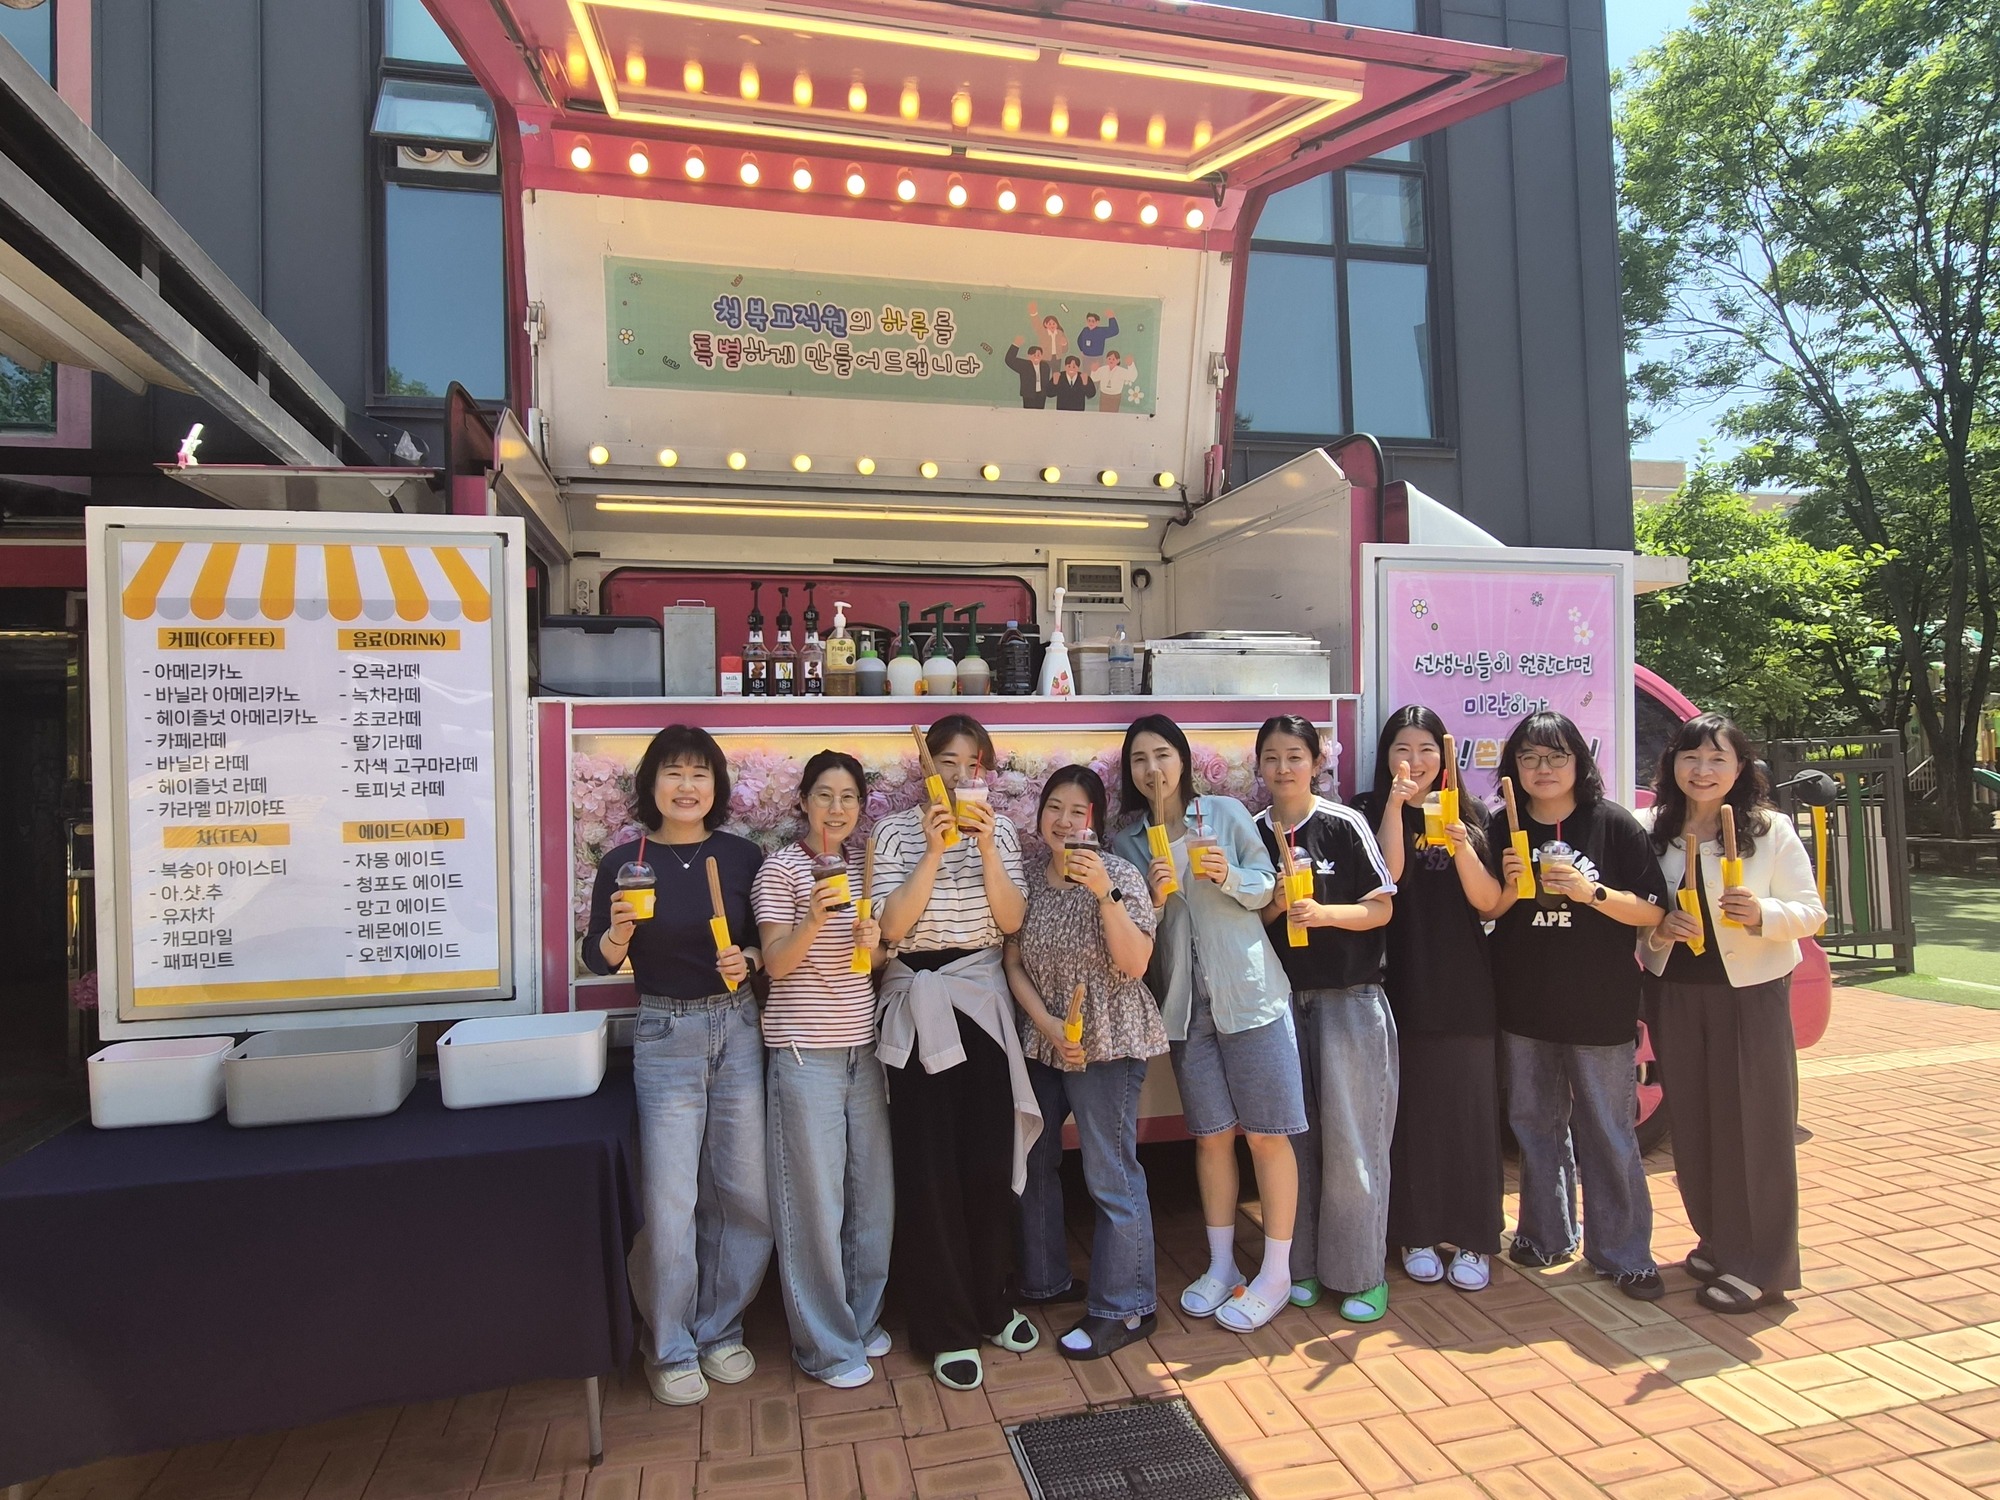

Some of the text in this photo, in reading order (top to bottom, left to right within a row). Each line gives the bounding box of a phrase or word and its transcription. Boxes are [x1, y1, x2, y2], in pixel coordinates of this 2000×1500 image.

[714, 295, 955, 346] 청북교직원의 하루를
[693, 333, 981, 377] 특별하게 만들어드립니다
[168, 631, 275, 648] 커피(COFFEE)
[353, 631, 446, 647] 음료(DRINK)
[155, 663, 243, 680] 아메리카노
[351, 663, 420, 680] 오곡라떼
[1415, 652, 1592, 681] 선생님들이 원한다면
[156, 686, 300, 703] 바닐라 아메리카노
[352, 687, 421, 703] 녹차라떼
[1464, 693, 1548, 716] 미란이가
[156, 708, 318, 726] 헤이즐넛 아메리카노
[352, 710, 421, 727] 초코라떼
[157, 732, 226, 749] 카페라떼
[353, 734, 422, 751] 딸기라떼
[157, 755, 249, 772] 바닐라 라떼
[354, 756, 478, 774] 자색 고구마라떼
[158, 777, 267, 795] 헤이즐넛 라떼
[354, 780, 445, 798] 토피넛 라떼
[159, 800, 286, 818] 카라멜 마끼야또
[196, 828, 258, 845] 차(TEA)
[358, 821, 449, 839] 에이드(ADE)
[161, 859, 287, 879] 복숭아 아이스티
[355, 851, 446, 869] 자몽 에이드
[356, 873, 463, 893] 청포도 에이드
[161, 884, 223, 901] 아.샷.추
[162, 907, 215, 925] 유자차
[357, 897, 447, 917] 망고 에이드
[1532, 911, 1572, 927] APE
[163, 929, 233, 947] 캐모마일
[358, 921, 443, 939] 레몬에이드
[163, 952, 234, 970] 패퍼민트
[359, 943, 461, 963] 오렌지에이드
